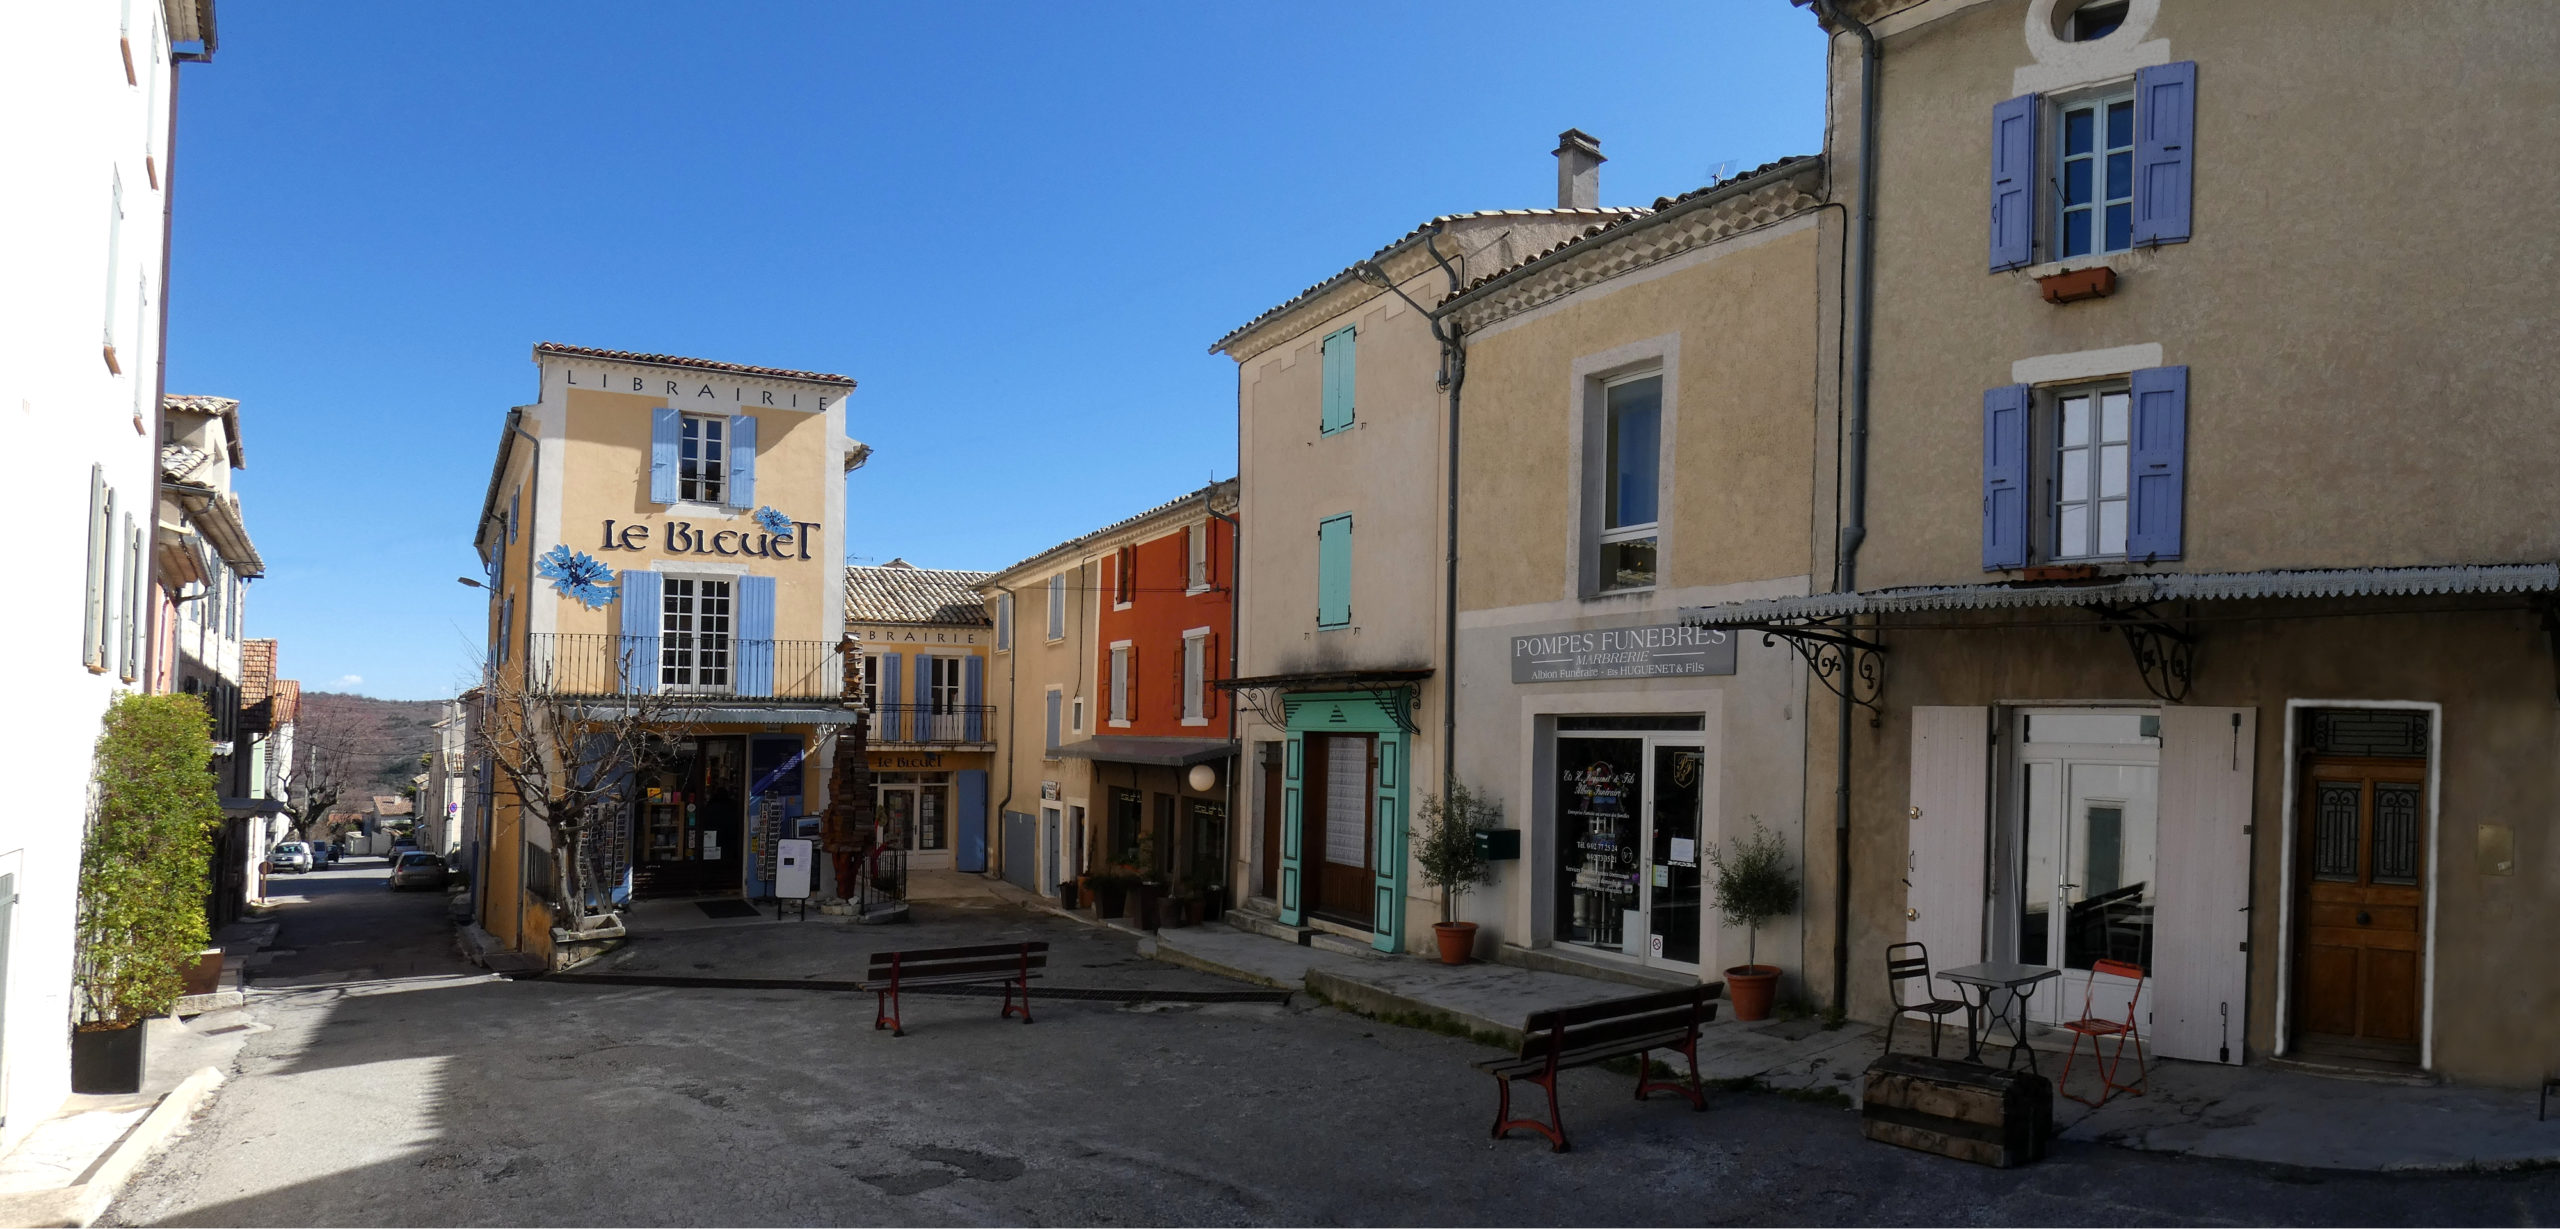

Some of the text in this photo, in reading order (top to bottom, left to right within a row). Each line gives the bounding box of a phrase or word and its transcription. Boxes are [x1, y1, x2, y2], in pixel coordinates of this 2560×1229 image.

[567, 369, 828, 411] LIBRAIRIE
[1516, 626, 1727, 657] POMPES FUNEBRES
[1575, 650, 1650, 665] MARBRERIE
[1531, 669, 1558, 680] Albion
[1559, 667, 1599, 678] Funéraire
[1620, 663, 1676, 676] HUGUENET
[1685, 662, 1705, 673] Fils
